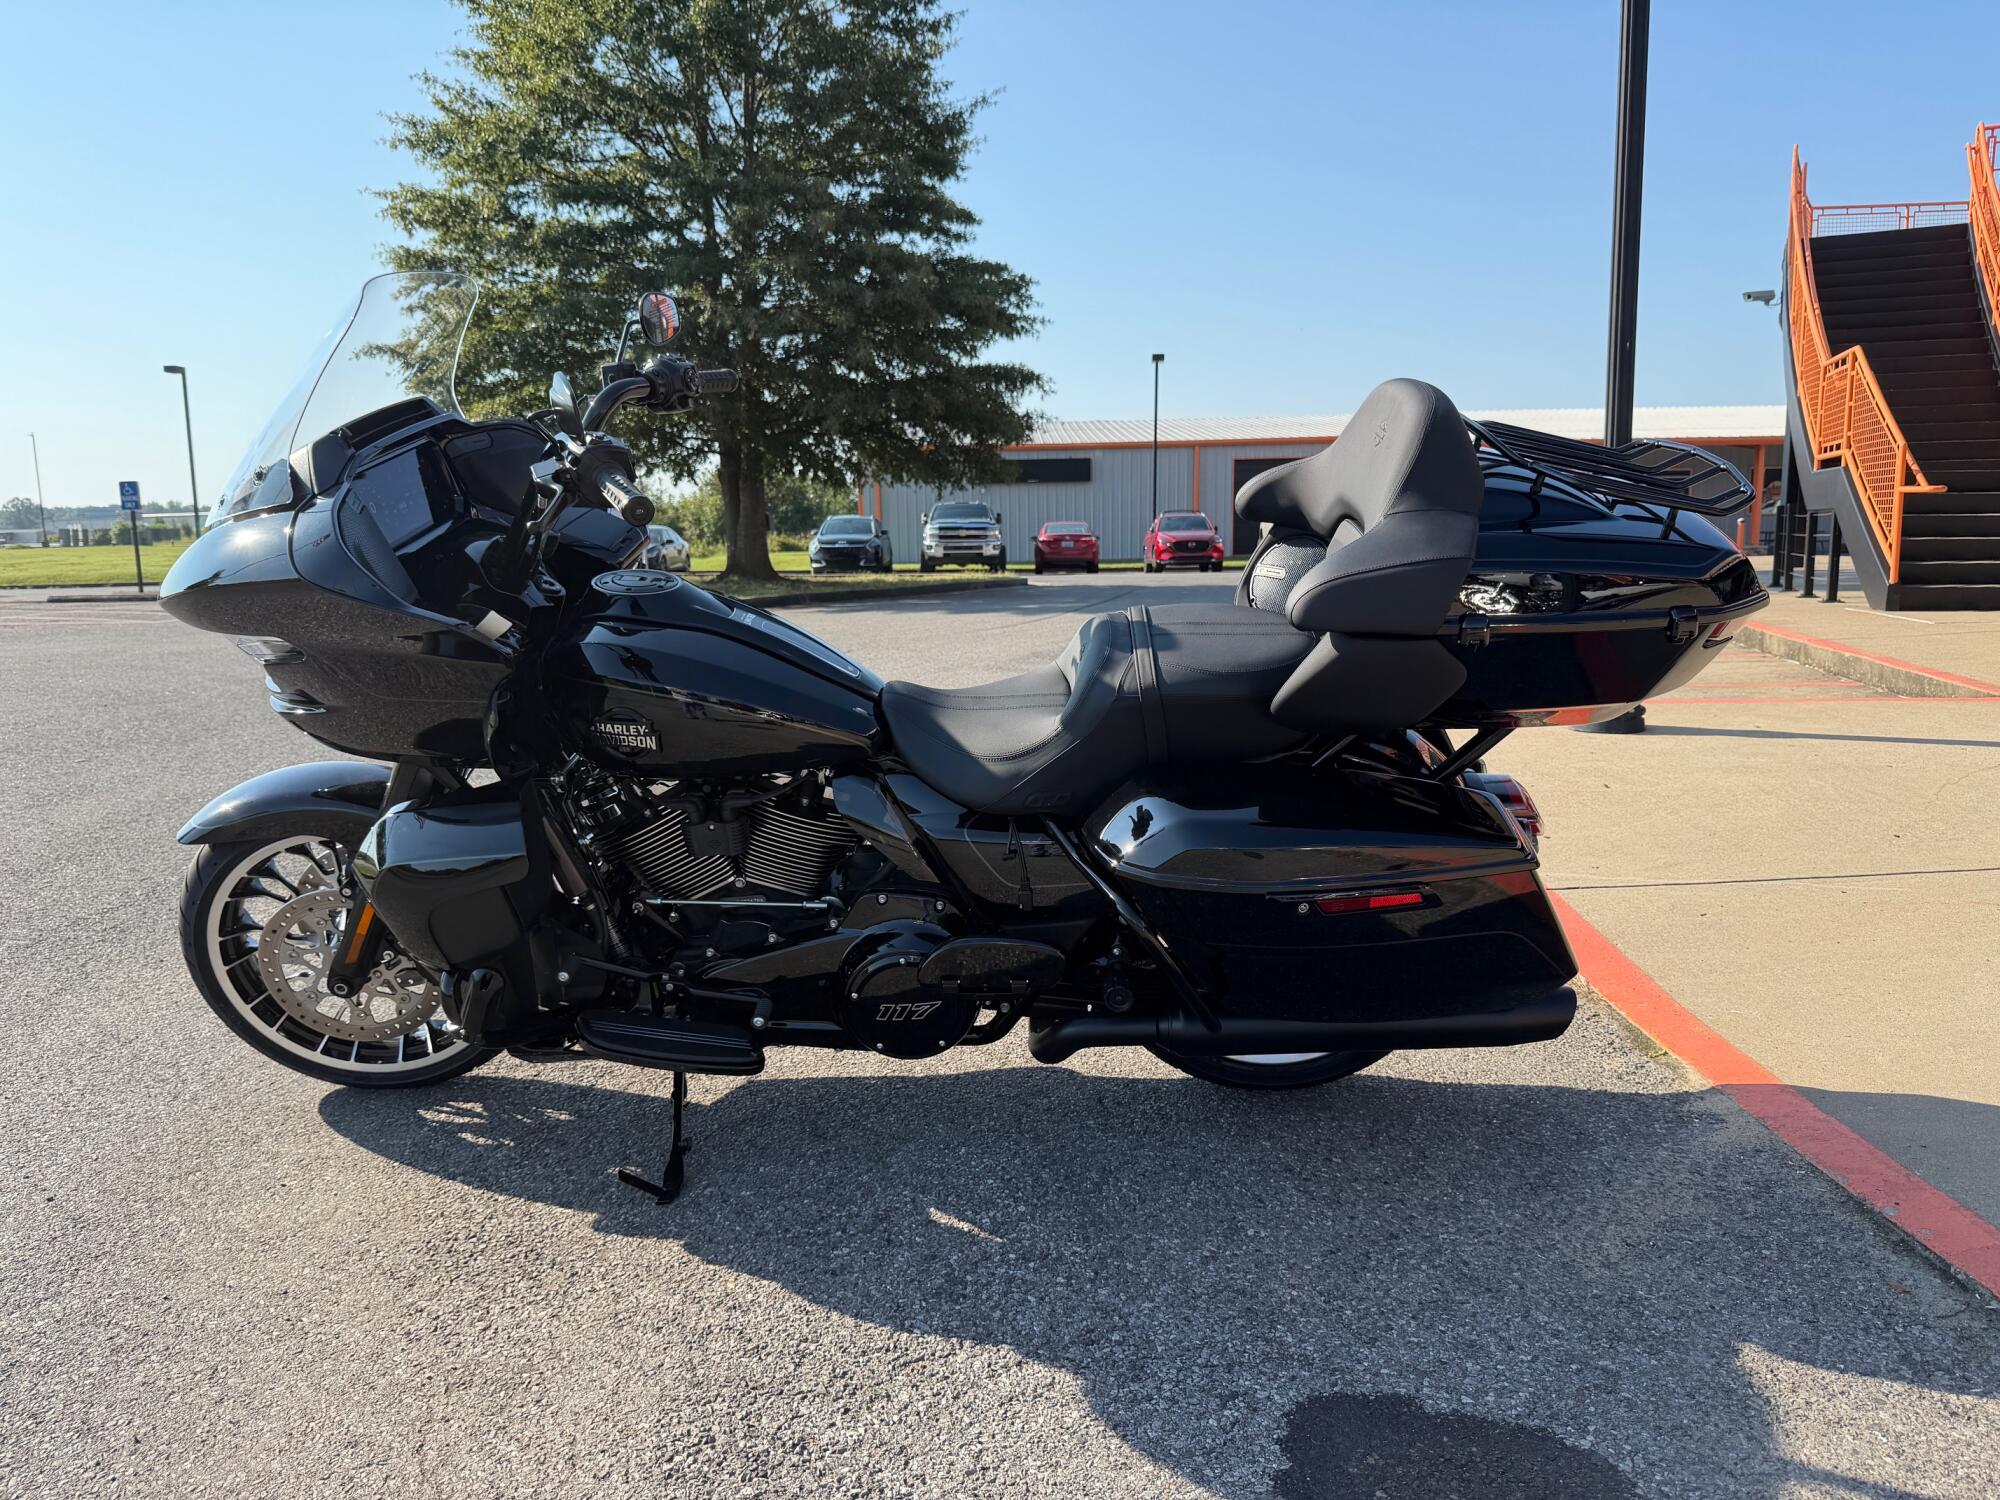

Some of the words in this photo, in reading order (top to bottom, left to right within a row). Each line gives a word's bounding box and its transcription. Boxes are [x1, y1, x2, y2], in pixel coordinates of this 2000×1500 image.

[597, 723, 648, 735] HARLEY-
[597, 733, 657, 750] AVIDSON
[876, 1001, 942, 1021] 117
